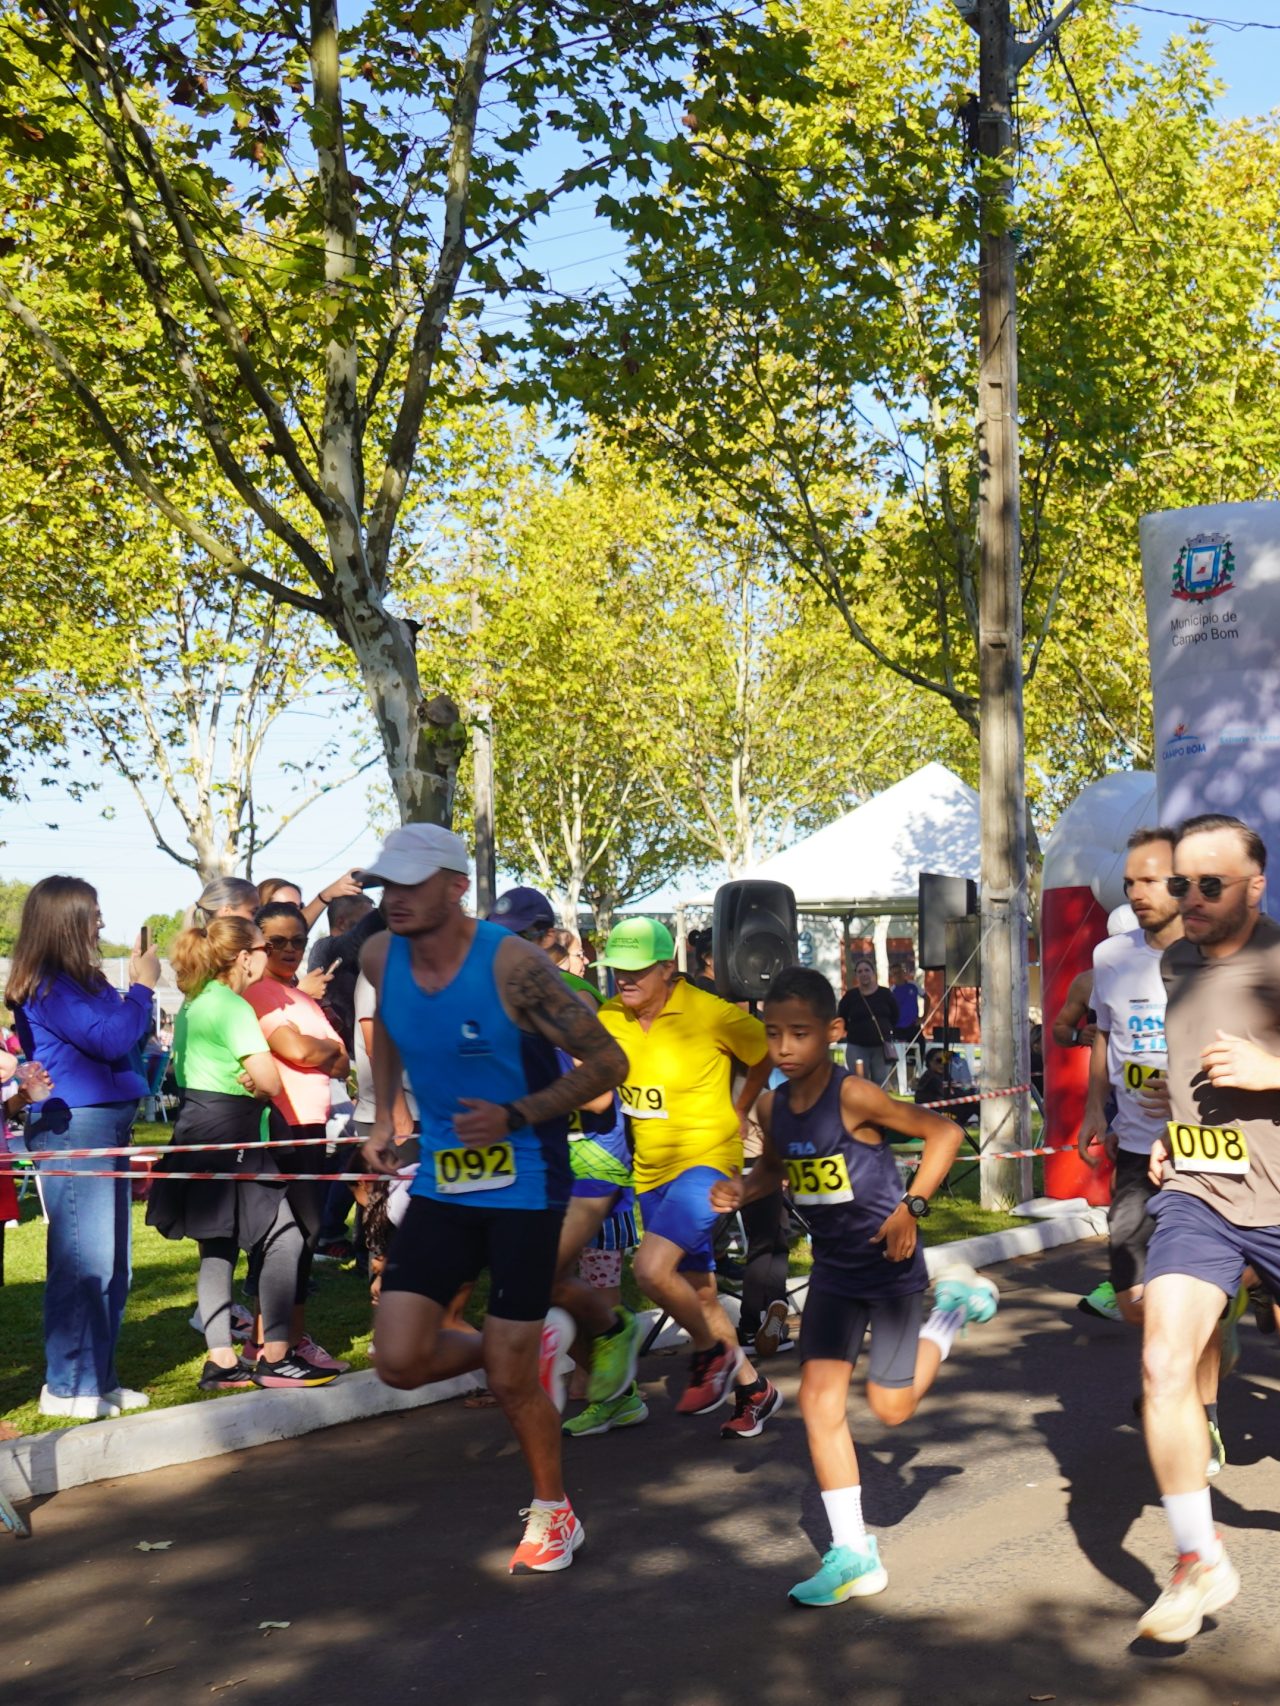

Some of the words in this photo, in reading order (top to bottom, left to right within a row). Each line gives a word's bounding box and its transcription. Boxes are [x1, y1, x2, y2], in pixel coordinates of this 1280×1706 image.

[1222, 611, 1238, 623] de
[1171, 632, 1208, 648] Campo
[1210, 627, 1239, 641] Bom
[1162, 748, 1185, 760] CAMPO
[1187, 743, 1206, 754] BOM
[620, 1084, 663, 1110] 079
[1176, 1125, 1243, 1160] 008
[440, 1145, 512, 1183] 092
